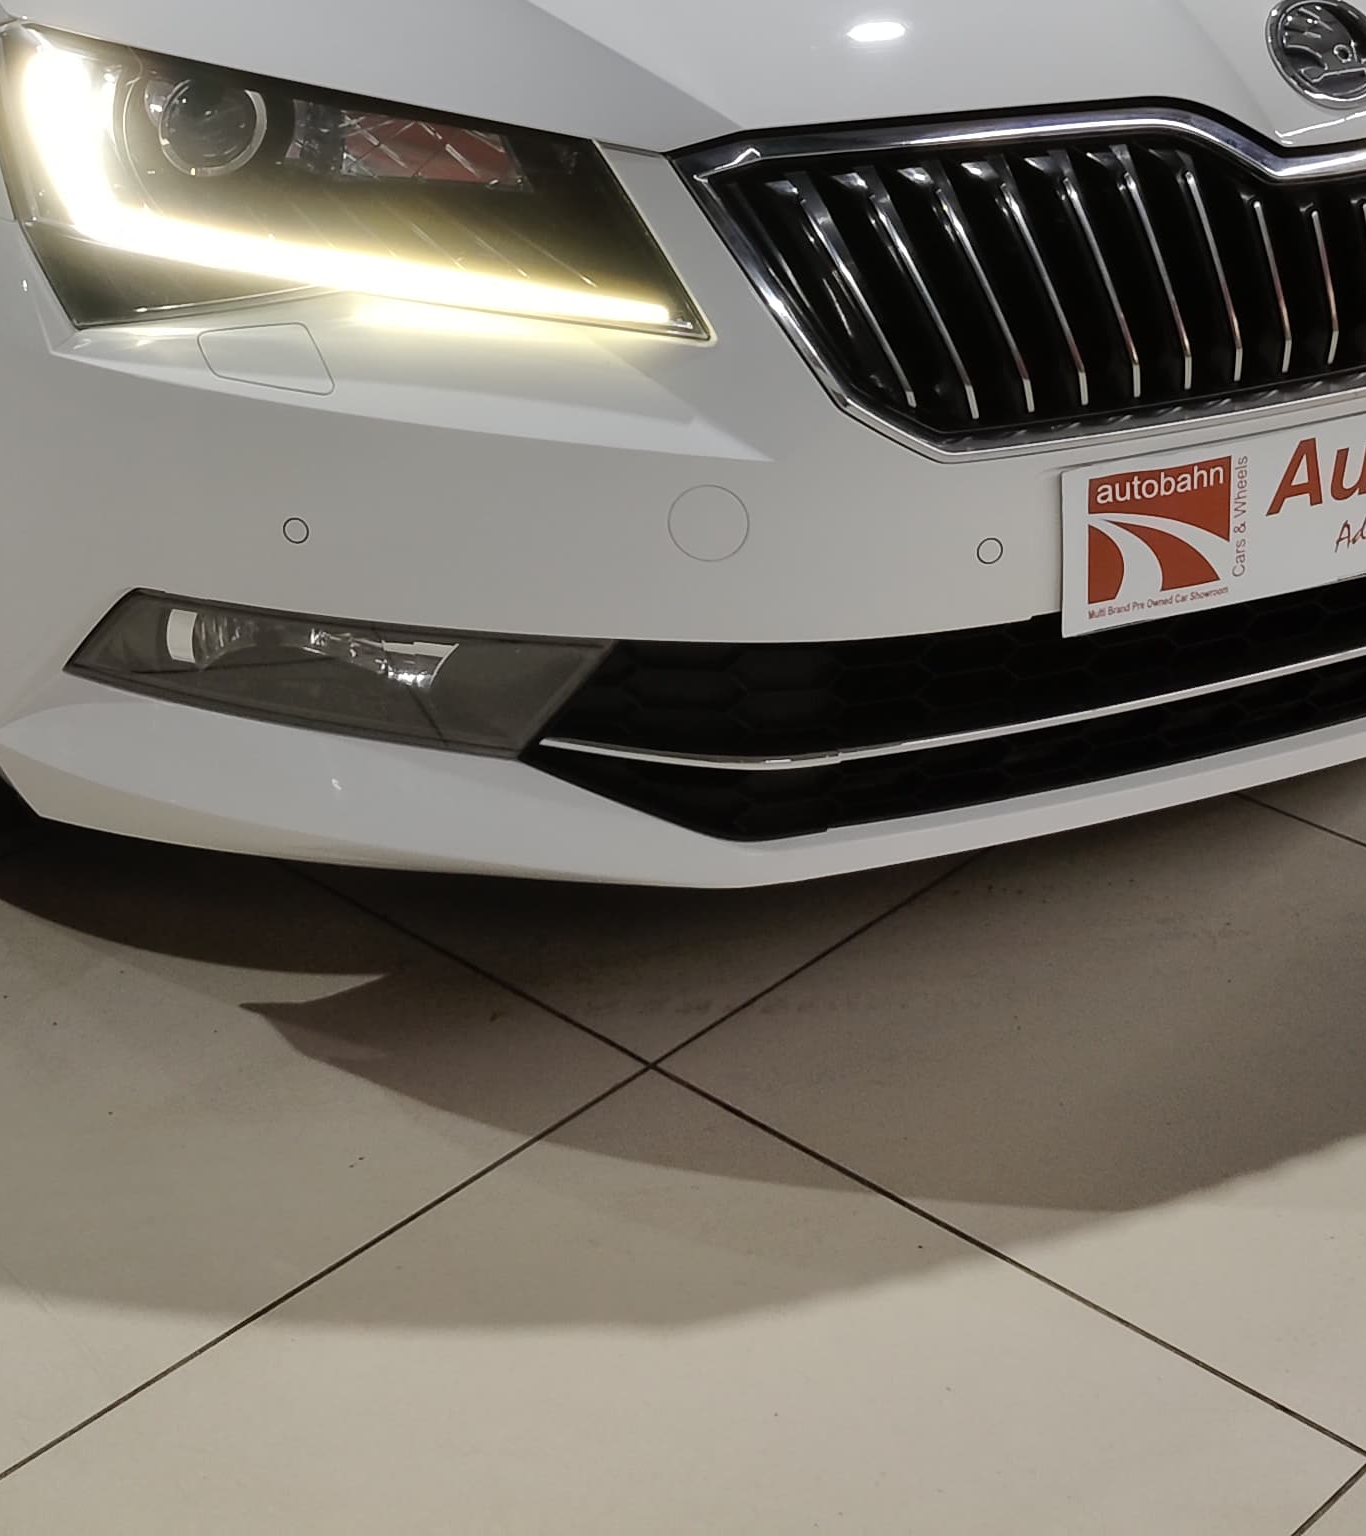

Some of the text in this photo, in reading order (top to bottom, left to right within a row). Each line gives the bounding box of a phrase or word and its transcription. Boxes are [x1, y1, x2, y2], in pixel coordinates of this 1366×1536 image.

[1095, 464, 1225, 506] autobahn
[1231, 455, 1249, 578] Cars & Wheels
[1088, 586, 1229, 620] Multi Brand Pre Owned Car Showroom
